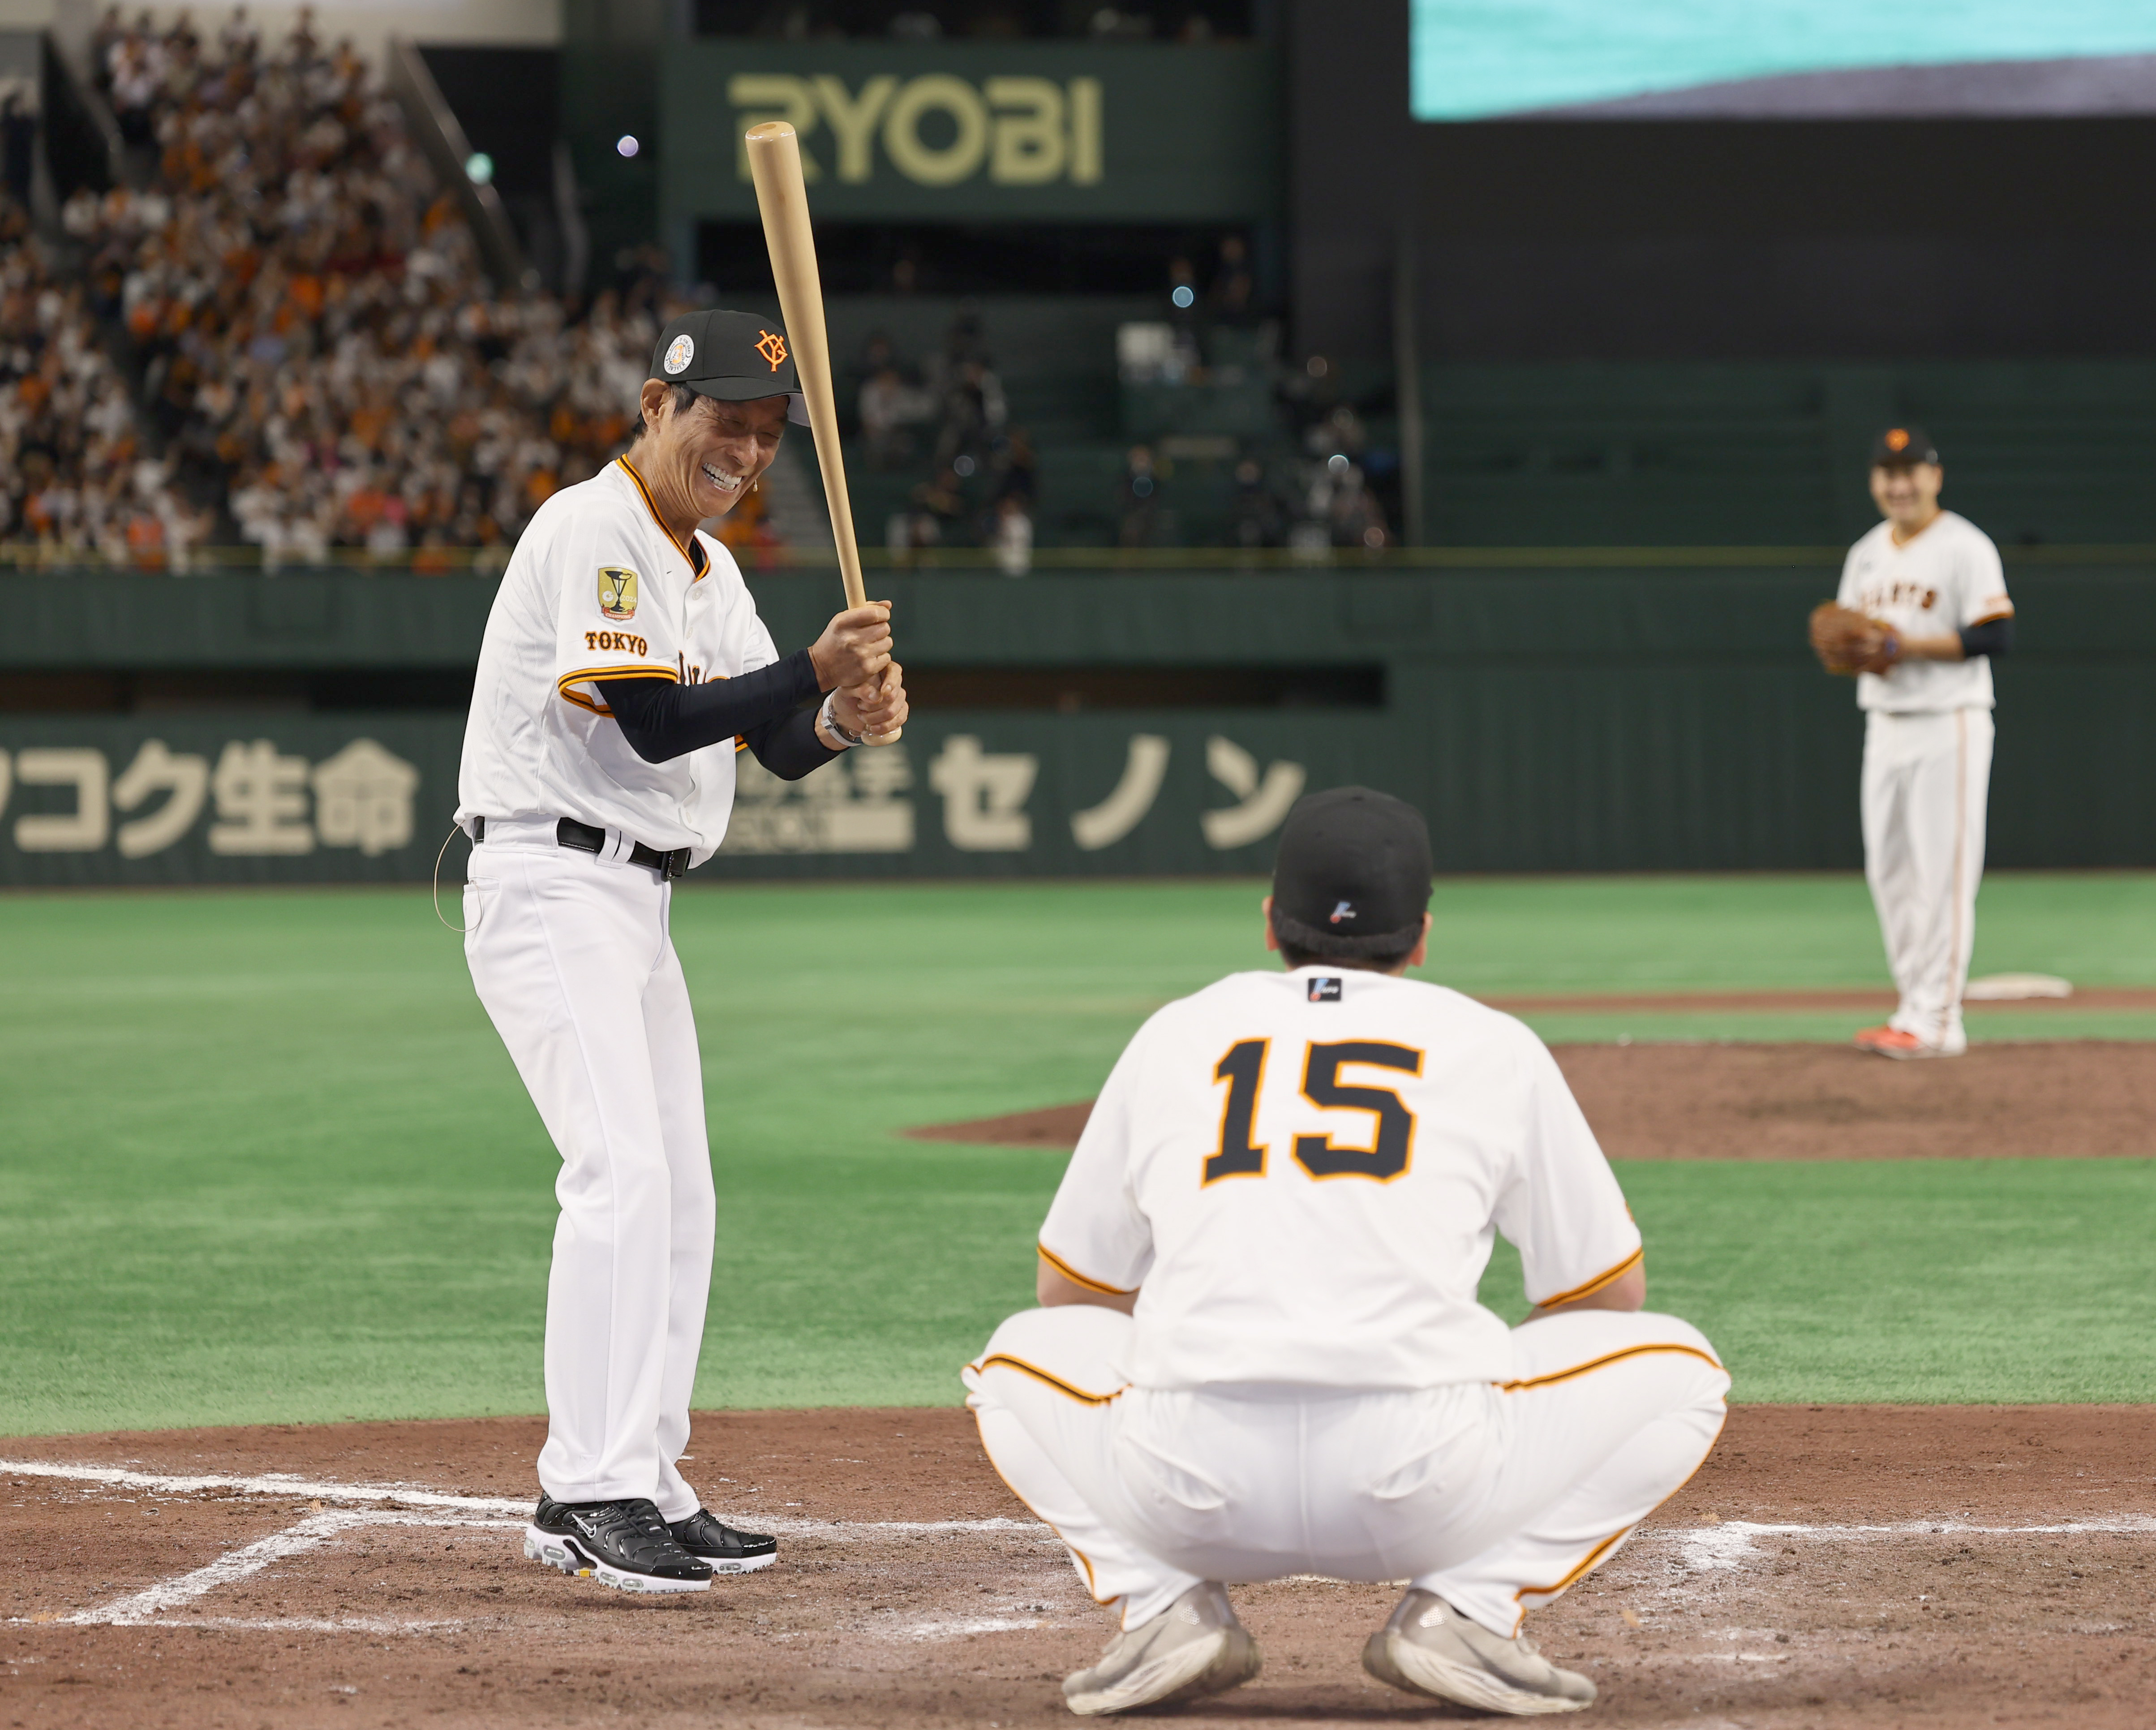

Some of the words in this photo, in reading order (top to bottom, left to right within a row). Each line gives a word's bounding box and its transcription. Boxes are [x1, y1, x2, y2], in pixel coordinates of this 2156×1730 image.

[726, 73, 1103, 186] RYOBI
[584, 631, 648, 658] TOKYO
[621, 594, 637, 603] 2024
[0, 738, 422, 859] コク生命
[928, 733, 1307, 851] セノン
[1201, 1037, 1425, 1189] 15
